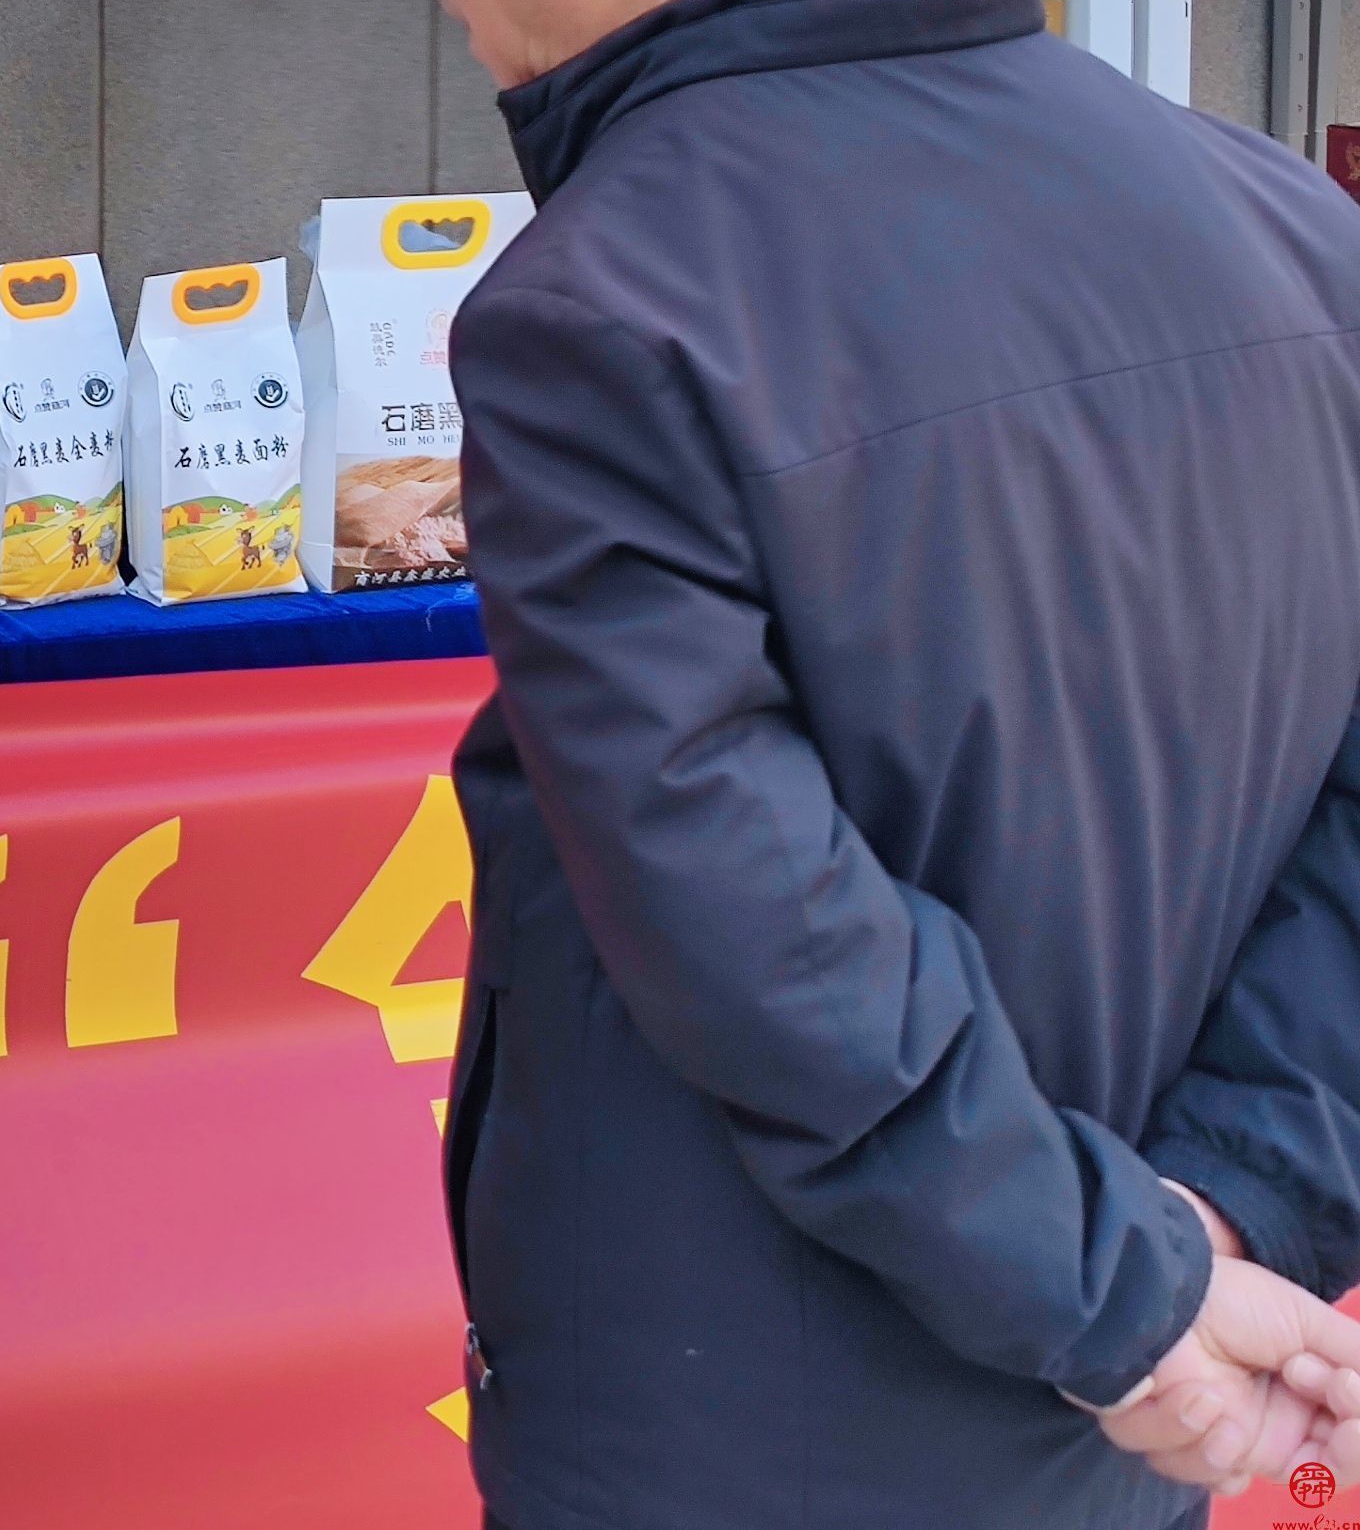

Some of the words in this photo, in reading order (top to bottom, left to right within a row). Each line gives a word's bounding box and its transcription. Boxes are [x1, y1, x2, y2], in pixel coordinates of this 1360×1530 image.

[174, 434, 290, 469] 石磨黑麦面粉
[387, 436, 406, 447] SHI
[417, 435, 435, 445] MO
